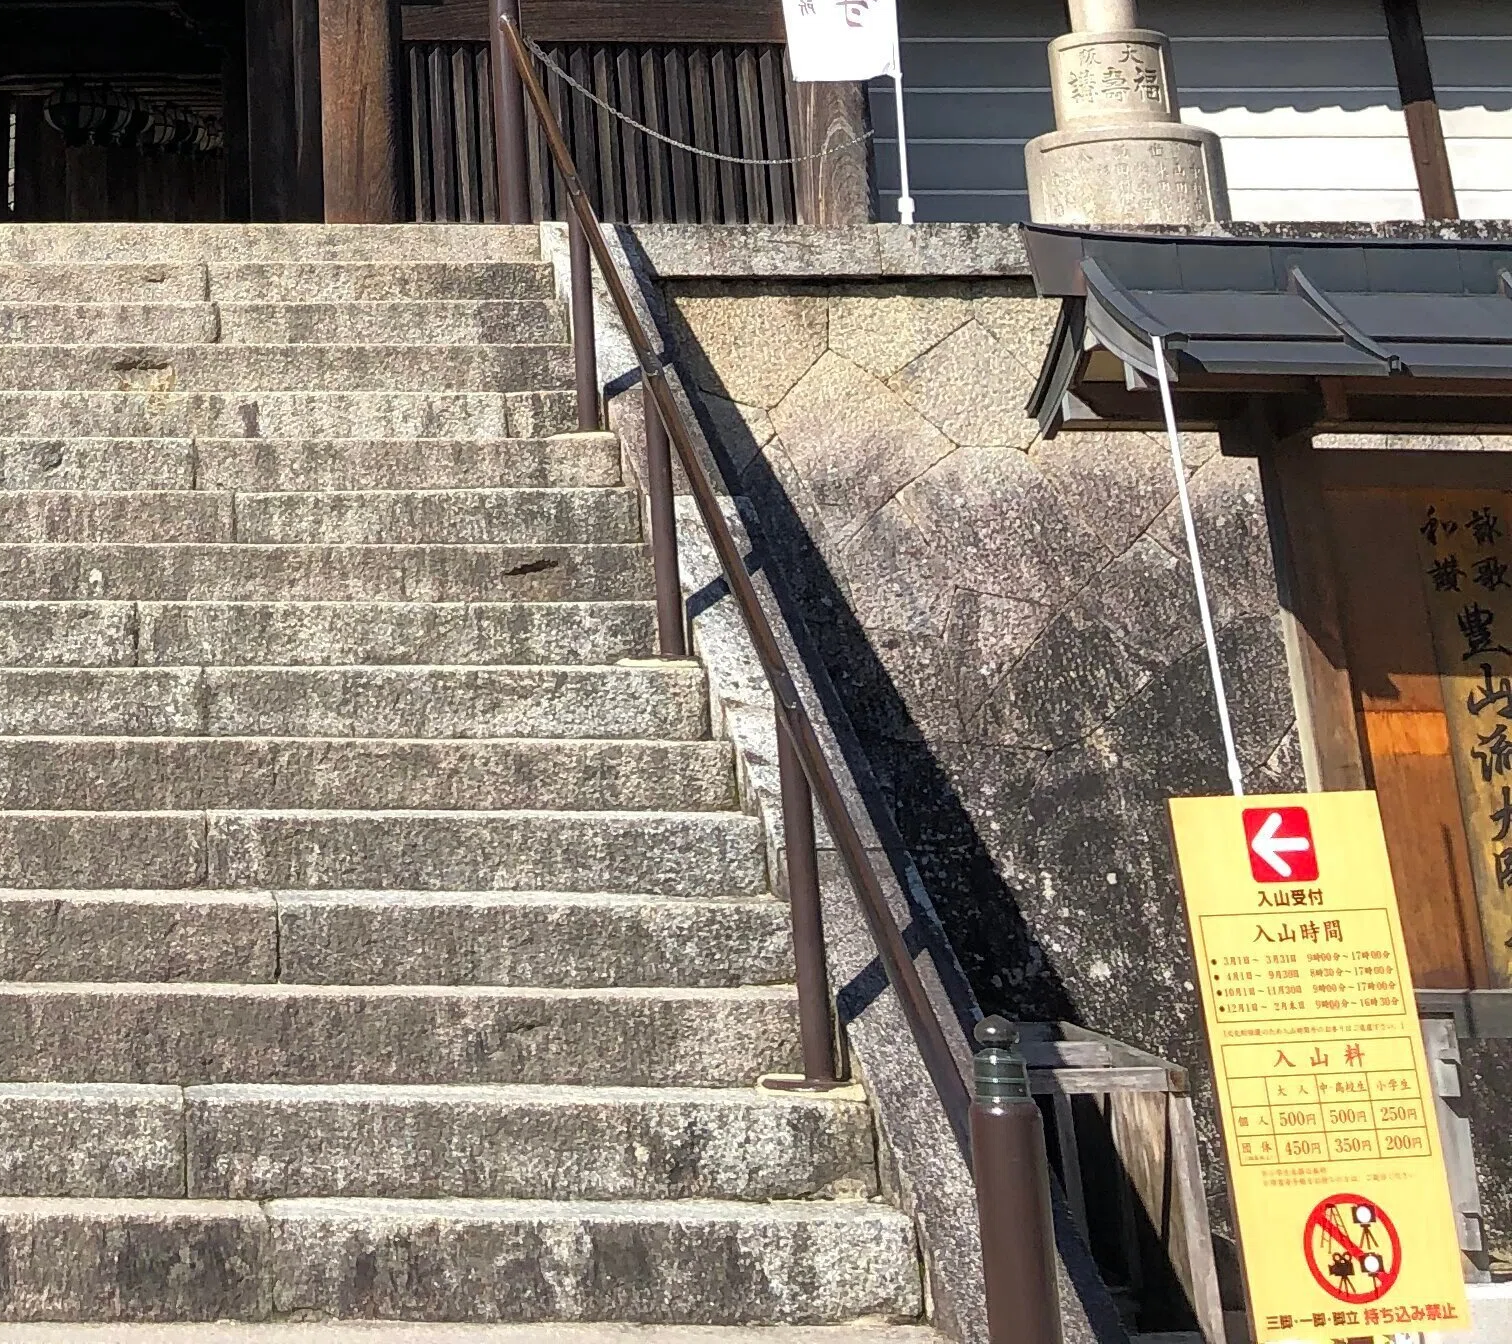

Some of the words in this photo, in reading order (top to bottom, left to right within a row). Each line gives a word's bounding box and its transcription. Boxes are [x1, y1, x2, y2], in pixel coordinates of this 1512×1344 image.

[1257, 888, 1324, 907] 入山受付
[1252, 919, 1344, 944] 入山時間
[1273, 1043, 1365, 1068] 入山料
[1277, 1084, 1309, 1096] 大人
[1376, 1077, 1412, 1091] 小学生
[1238, 1115, 1269, 1127] 個人
[1279, 1111, 1317, 1127] 500円
[1329, 1108, 1368, 1124] 500円
[1380, 1106, 1418, 1122] 250円
[1241, 1141, 1273, 1154] 団体
[1285, 1140, 1322, 1156] 450円
[1334, 1137, 1372, 1153] 350円
[1384, 1134, 1423, 1151] 200円
[1363, 1302, 1459, 1325] 持ち込み禁止
